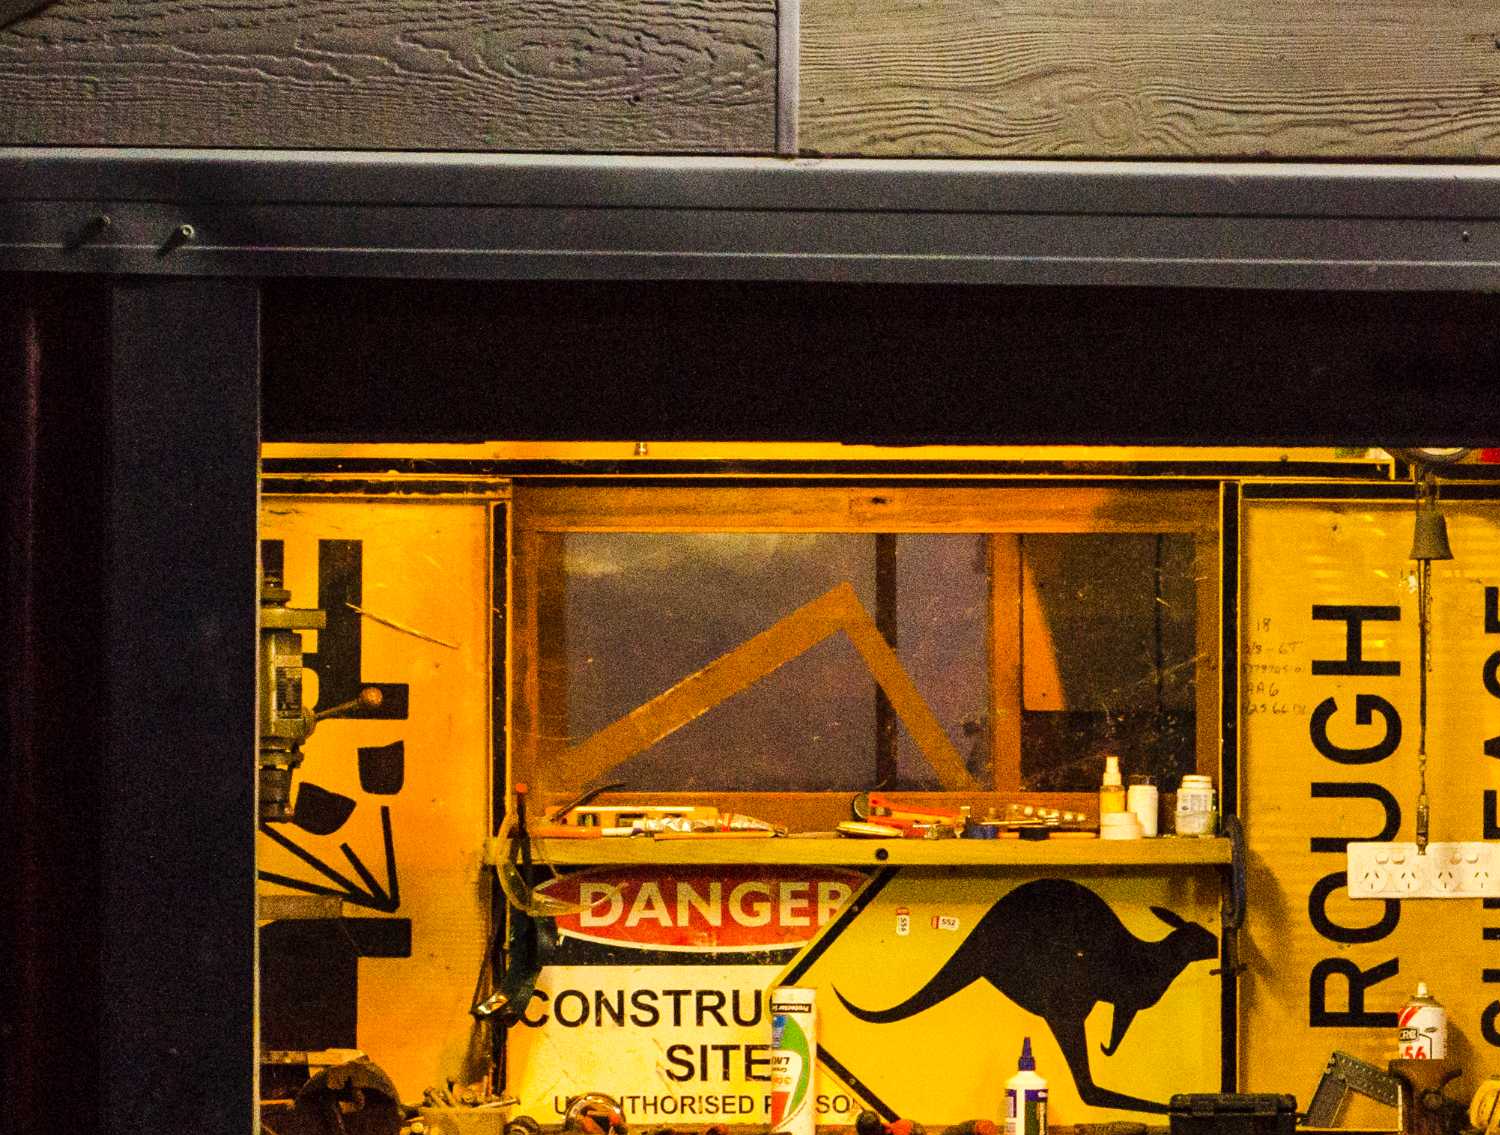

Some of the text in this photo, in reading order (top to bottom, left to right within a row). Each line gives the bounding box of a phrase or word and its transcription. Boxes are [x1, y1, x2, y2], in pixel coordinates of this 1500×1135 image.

[1308, 604, 1402, 1028] ROUGH
[580, 882, 853, 928] DANGER
[521, 989, 774, 1028] CONSTRU
[665, 1043, 773, 1082] SITE
